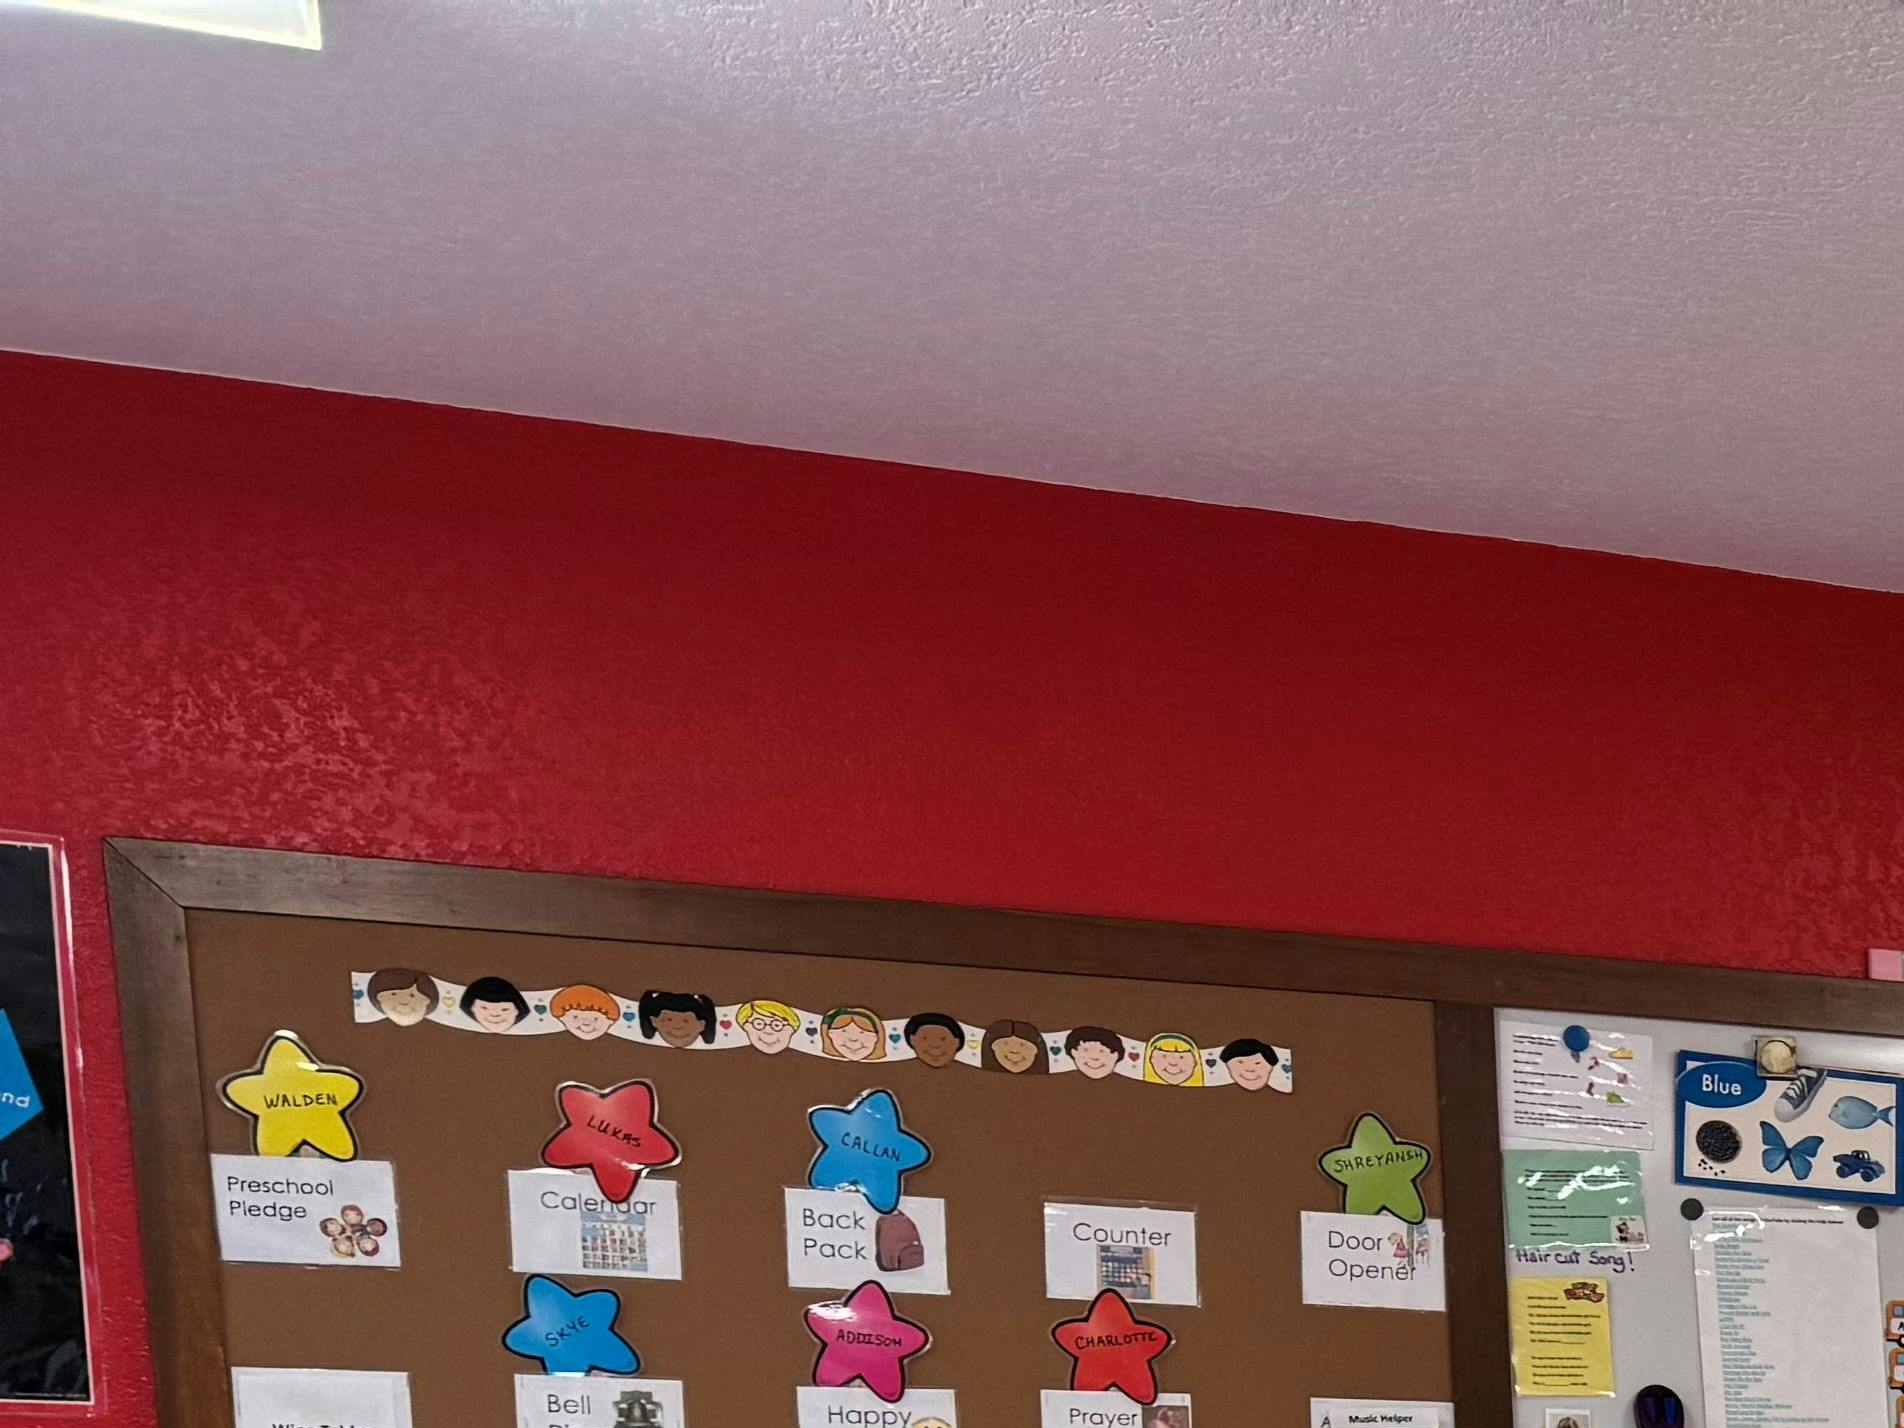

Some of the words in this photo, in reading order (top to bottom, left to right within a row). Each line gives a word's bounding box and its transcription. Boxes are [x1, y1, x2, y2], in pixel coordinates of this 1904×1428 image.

[1702, 1074, 1742, 1096] Blue
[263, 1091, 338, 1111] WALDEN
[585, 1114, 643, 1149] LUKAS
[840, 1131, 901, 1162] CALLAN
[226, 1175, 335, 1198] Preschool
[229, 1199, 308, 1222] Pledge
[803, 1209, 865, 1231] Back
[1072, 1222, 1172, 1247] Counter
[1328, 1230, 1383, 1252] Door
[803, 1237, 867, 1260] Pack
[1328, 1258, 1417, 1282] Opener
[1589, 1251, 1635, 1272] Song!
[546, 1316, 590, 1348] SKYE
[835, 1329, 902, 1347] ADDISON
[1075, 1330, 1158, 1350] CHARLOTTE
[546, 1393, 593, 1416] Bell
